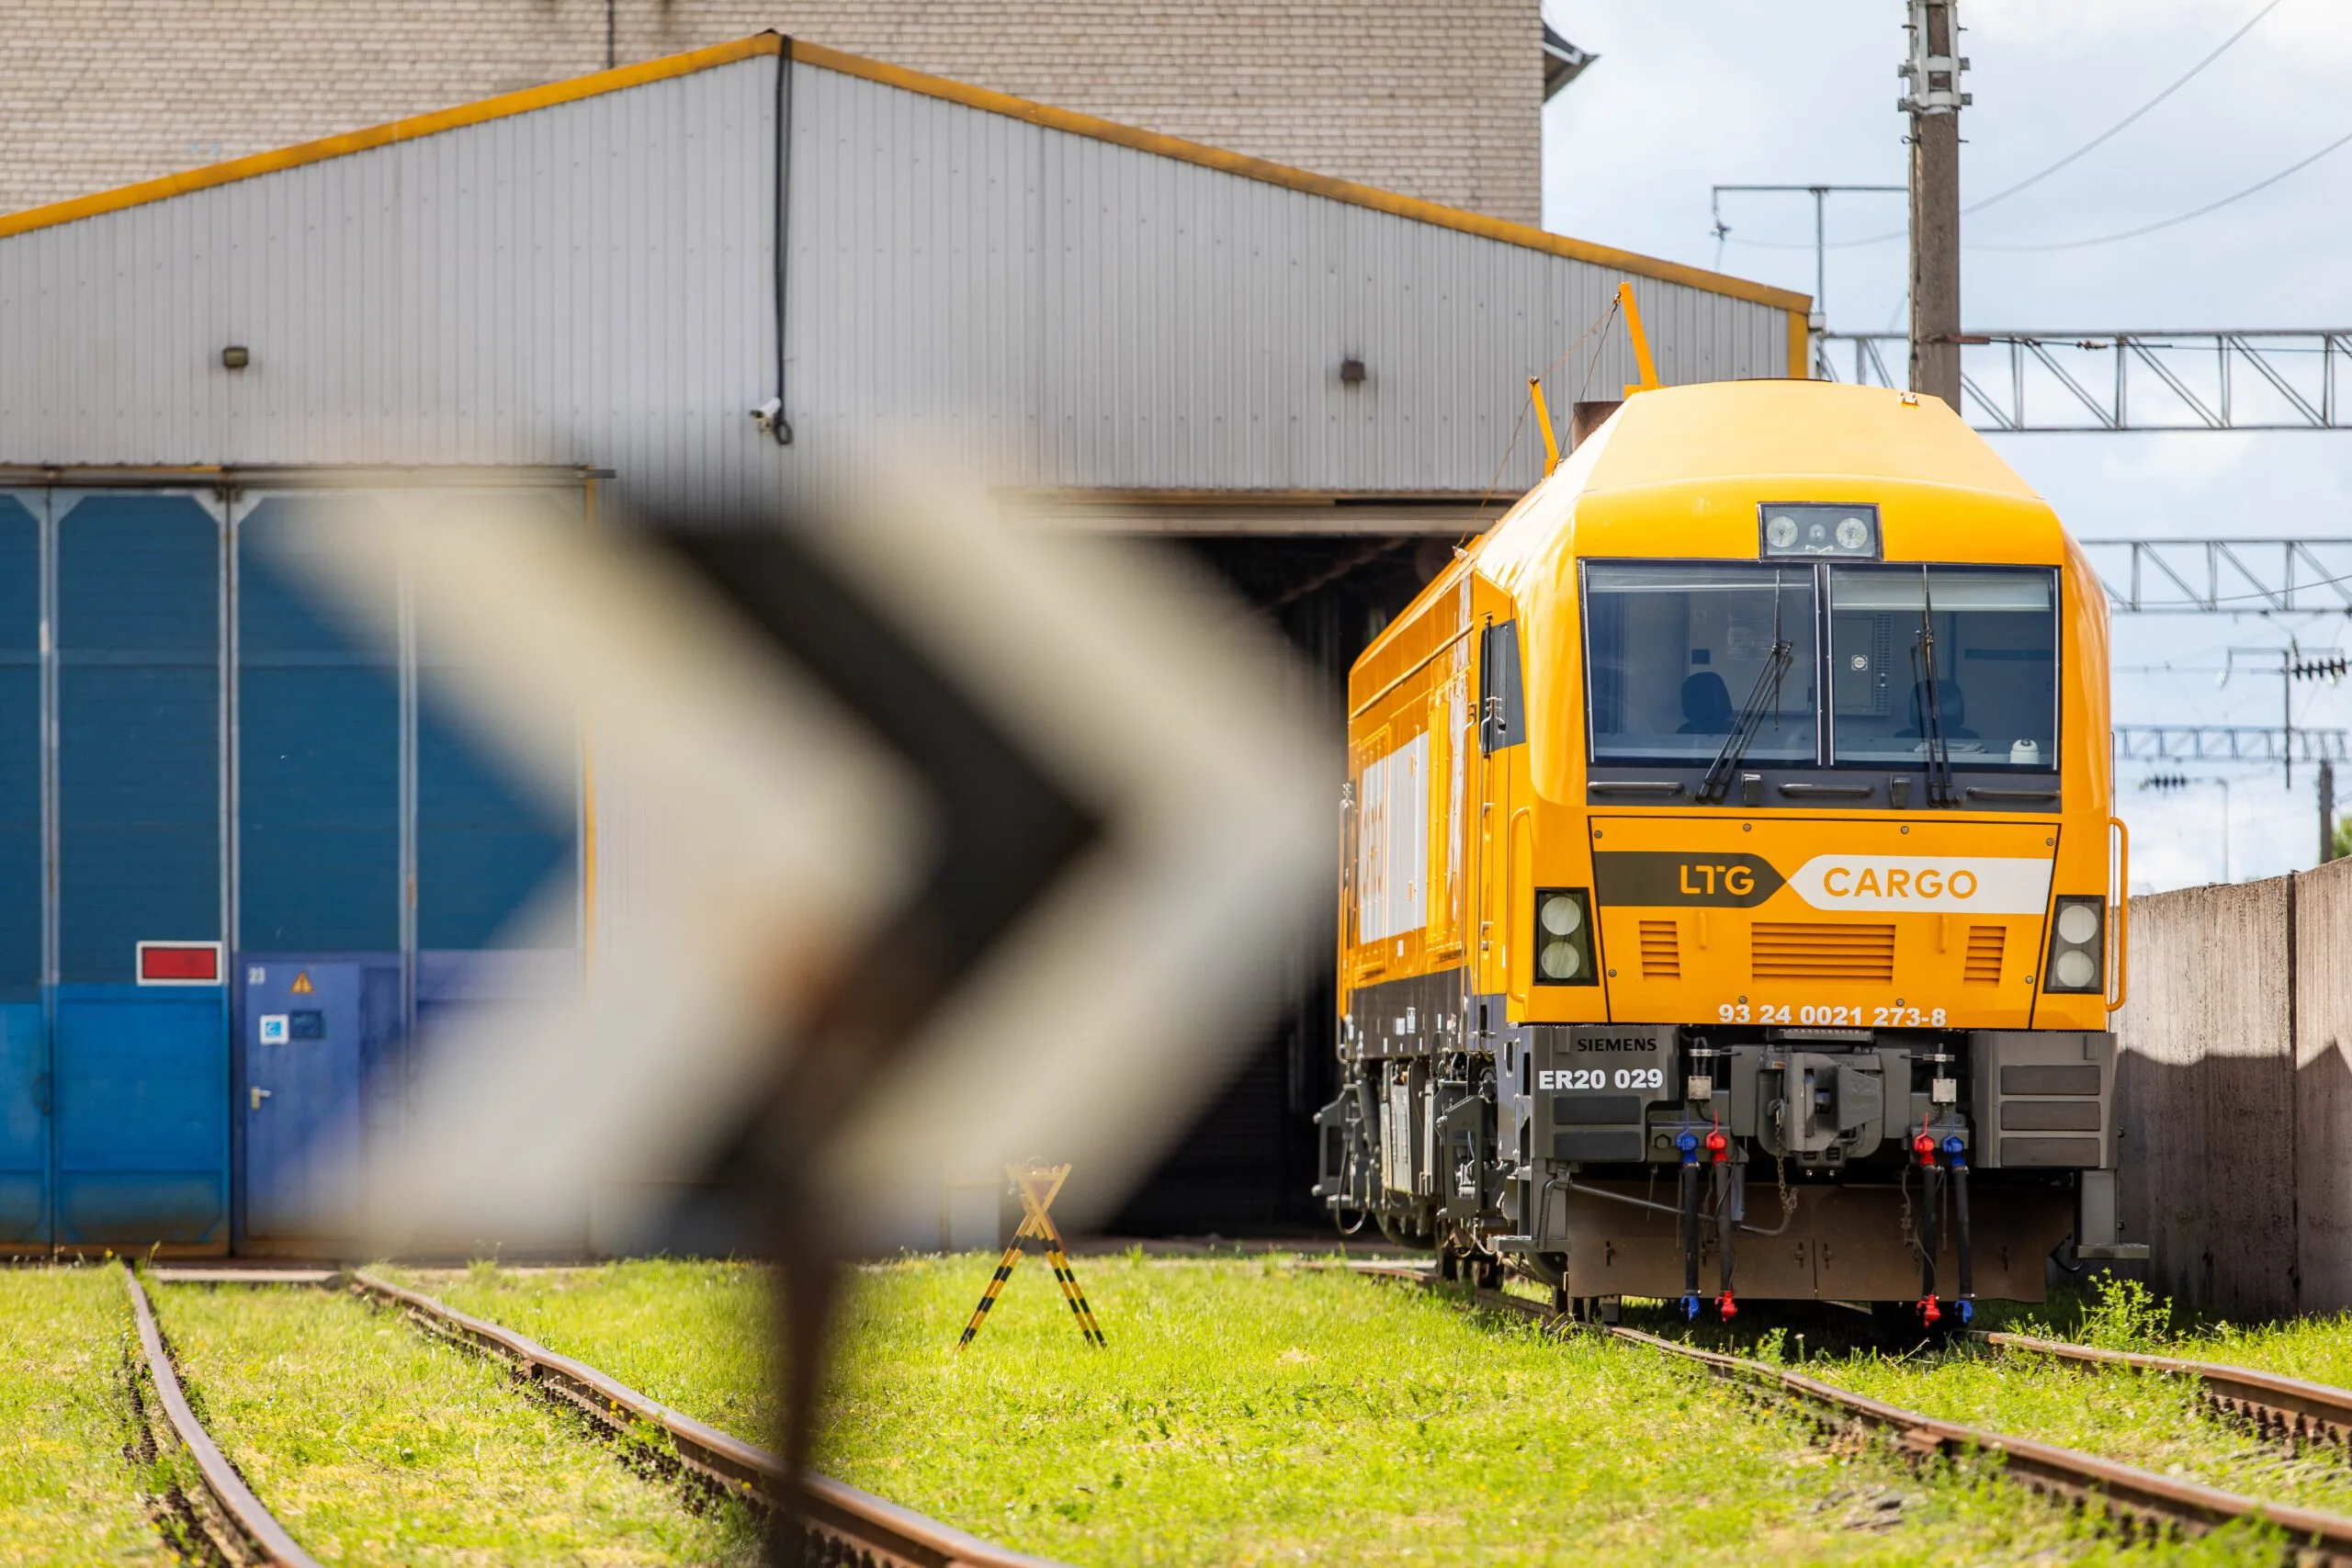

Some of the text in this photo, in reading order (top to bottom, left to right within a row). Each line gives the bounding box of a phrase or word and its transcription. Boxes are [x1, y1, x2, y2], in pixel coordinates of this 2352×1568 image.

[1679, 864, 1978, 899] LTG CARGO
[1718, 1003, 1947, 1027] 93 24 0021 273-8
[1577, 1038, 1657, 1053] SIEMENS
[1538, 1068, 1664, 1090] ER20 029
